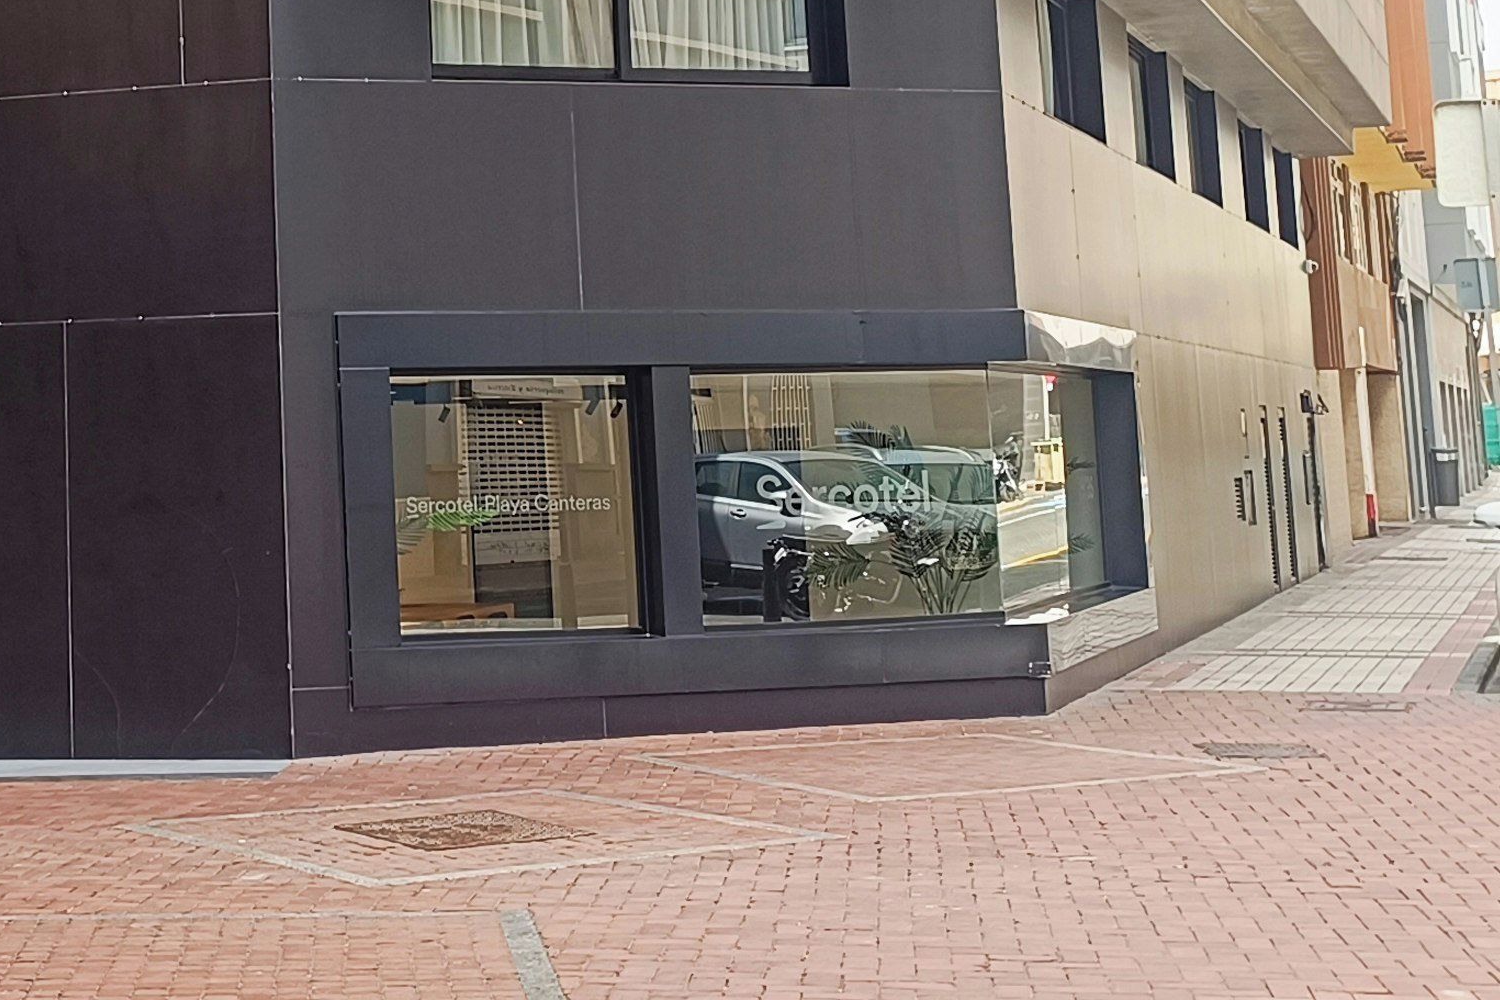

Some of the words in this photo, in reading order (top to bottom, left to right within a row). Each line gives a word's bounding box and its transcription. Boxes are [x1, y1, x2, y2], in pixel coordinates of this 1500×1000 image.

[406, 496, 479, 515] Sercotel
[485, 495, 530, 515] Playa
[534, 494, 611, 512] Canteras
[756, 469, 931, 518] Sercotel
